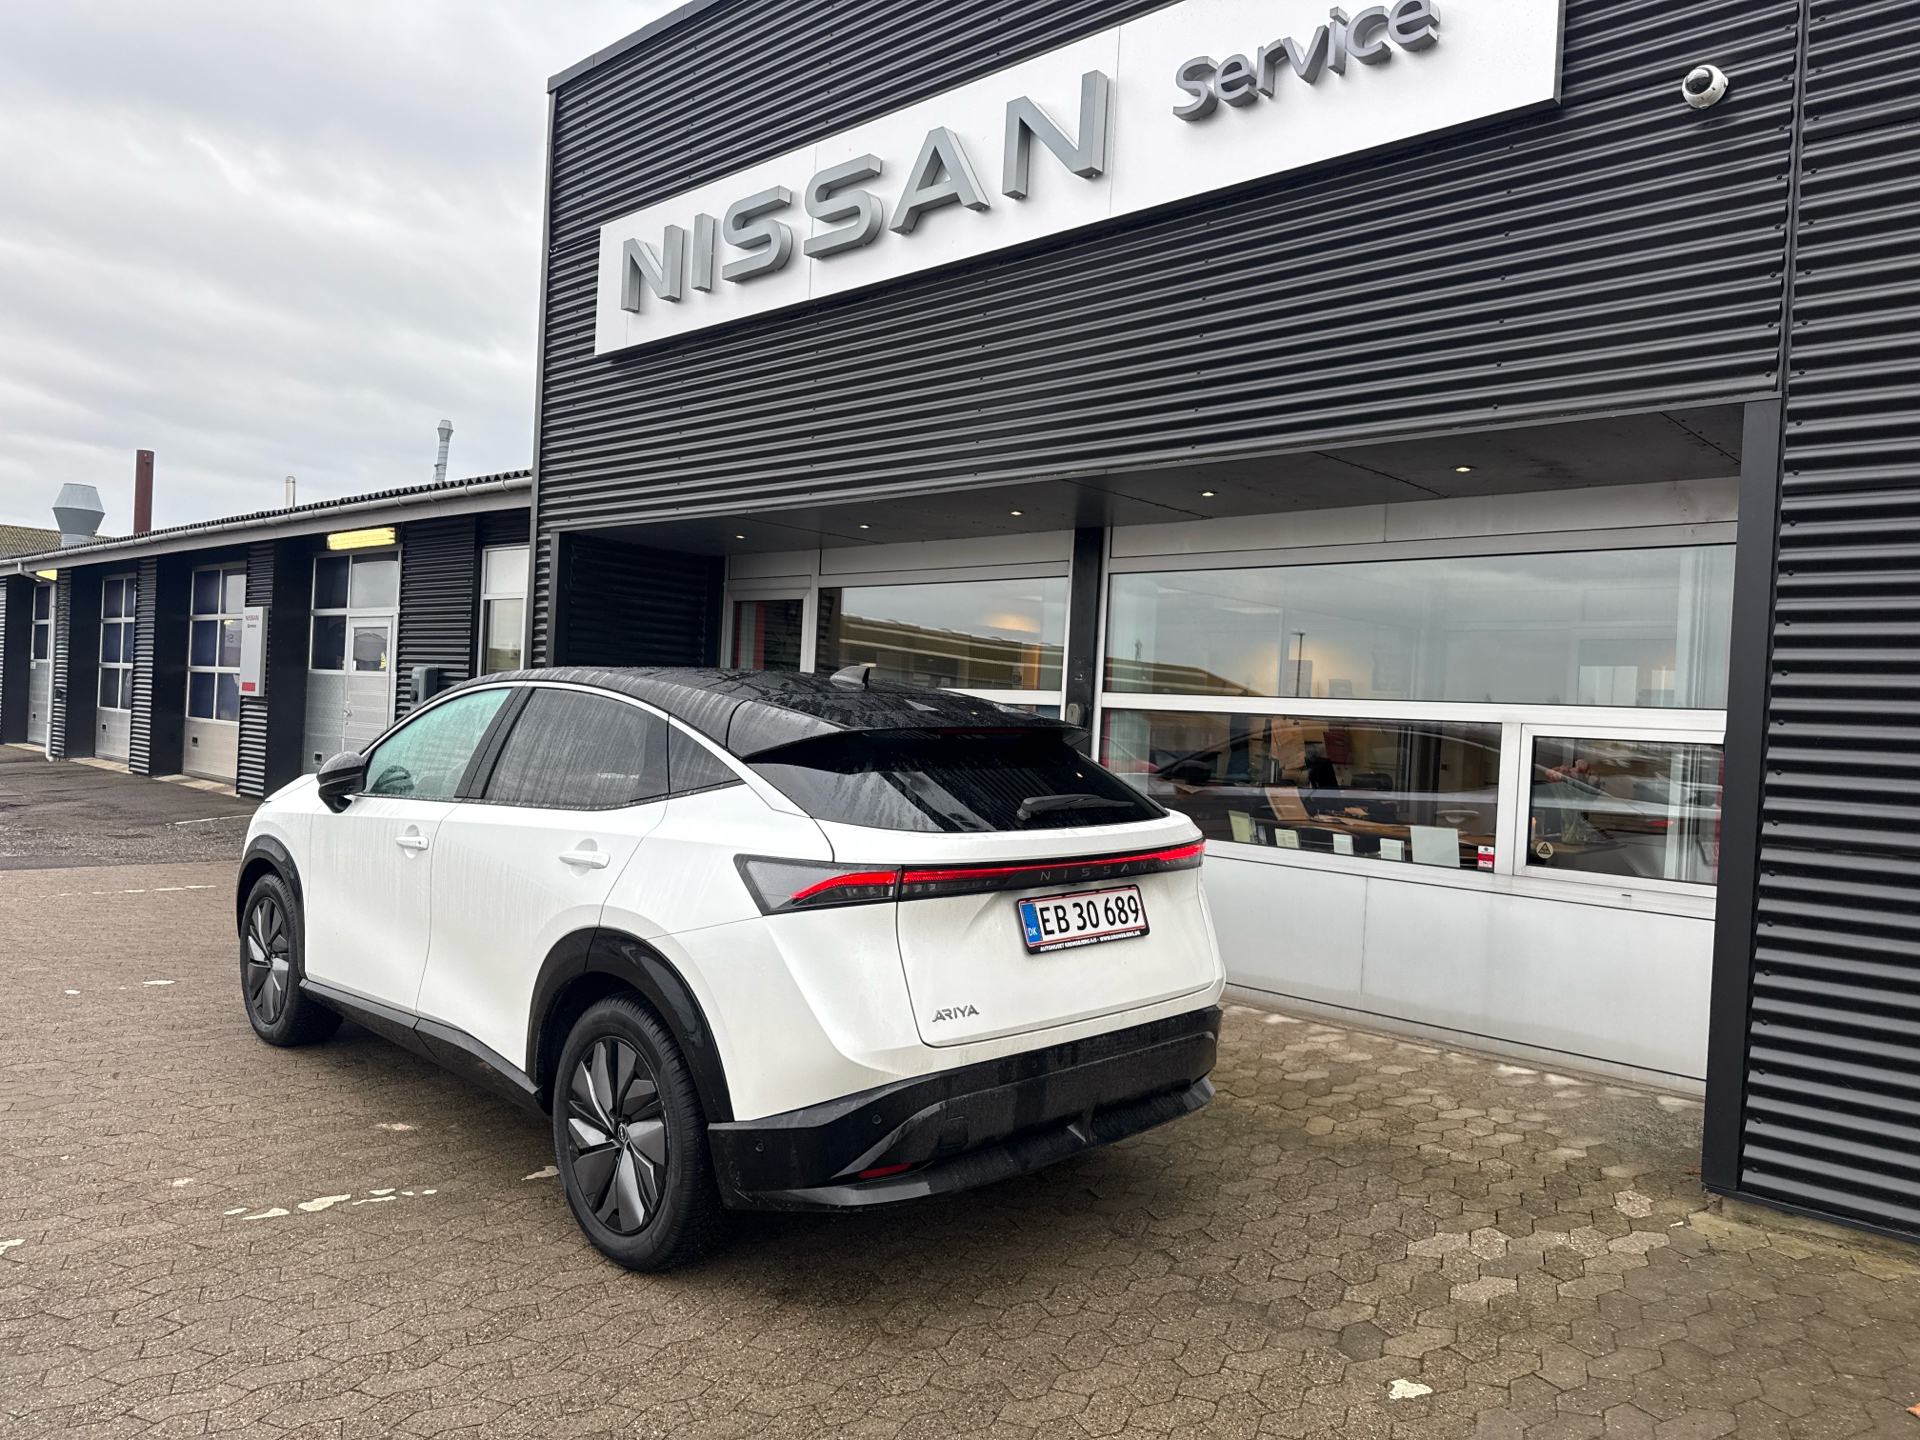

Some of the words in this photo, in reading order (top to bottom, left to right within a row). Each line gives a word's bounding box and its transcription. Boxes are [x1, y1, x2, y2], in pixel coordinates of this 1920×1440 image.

[621, 70, 1108, 313] NISSAN
[1040, 861, 1148, 881] NISSAN
[1039, 905, 1070, 936] EB
[1072, 900, 1100, 931] 30
[1104, 894, 1140, 926] 689
[1027, 926, 1038, 937] DK
[931, 1004, 980, 1023] ARIYA
